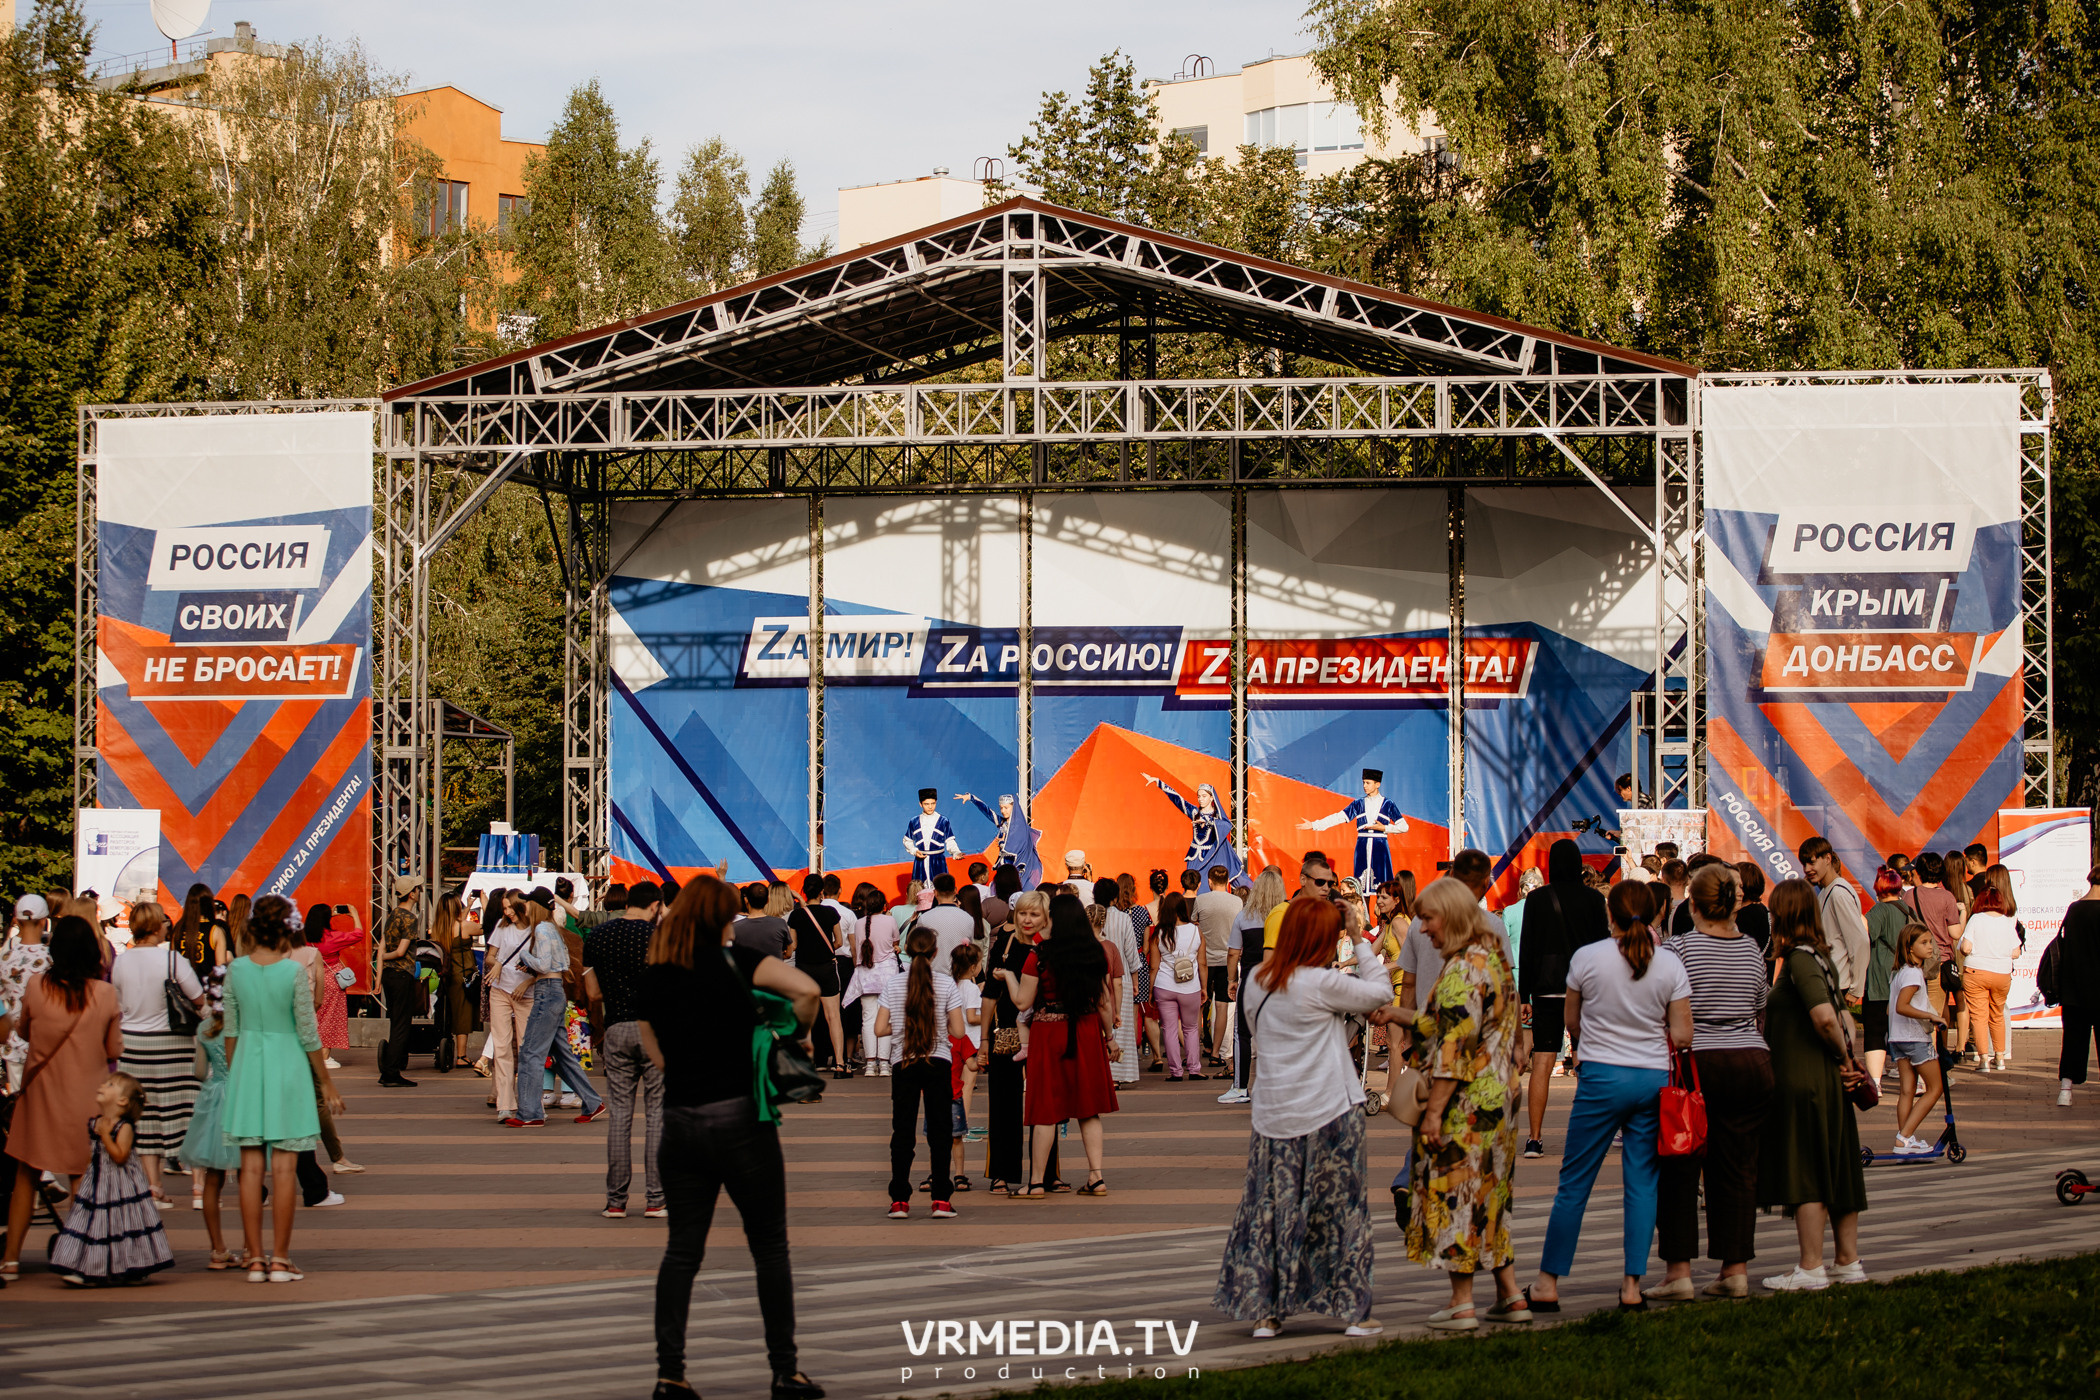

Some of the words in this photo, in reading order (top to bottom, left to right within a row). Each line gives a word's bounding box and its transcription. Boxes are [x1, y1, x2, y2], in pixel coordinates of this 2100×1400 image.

[1793, 522, 1956, 552] РОССИЯ
[168, 541, 310, 571] РОССИЯ
[179, 603, 288, 631] СВОИХ
[1810, 588, 1926, 616] КРЫМ
[143, 657, 187, 683] НЕ
[194, 655, 343, 683] БРОСАЕТ!
[825, 632, 914, 659] МИР!
[999, 643, 1173, 672] РОССИЮ!
[1273, 655, 1516, 688] ПРЕЗИДЕНТА!
[1781, 644, 1955, 678] ДОНБАСС
[266, 863, 298, 896] СИЮ!
[305, 774, 363, 851] ПРЕЗИДЕНТА!
[1719, 791, 1776, 853] РОССИЯ
[2016, 906, 2054, 914] ЕРОВСКАЯ
